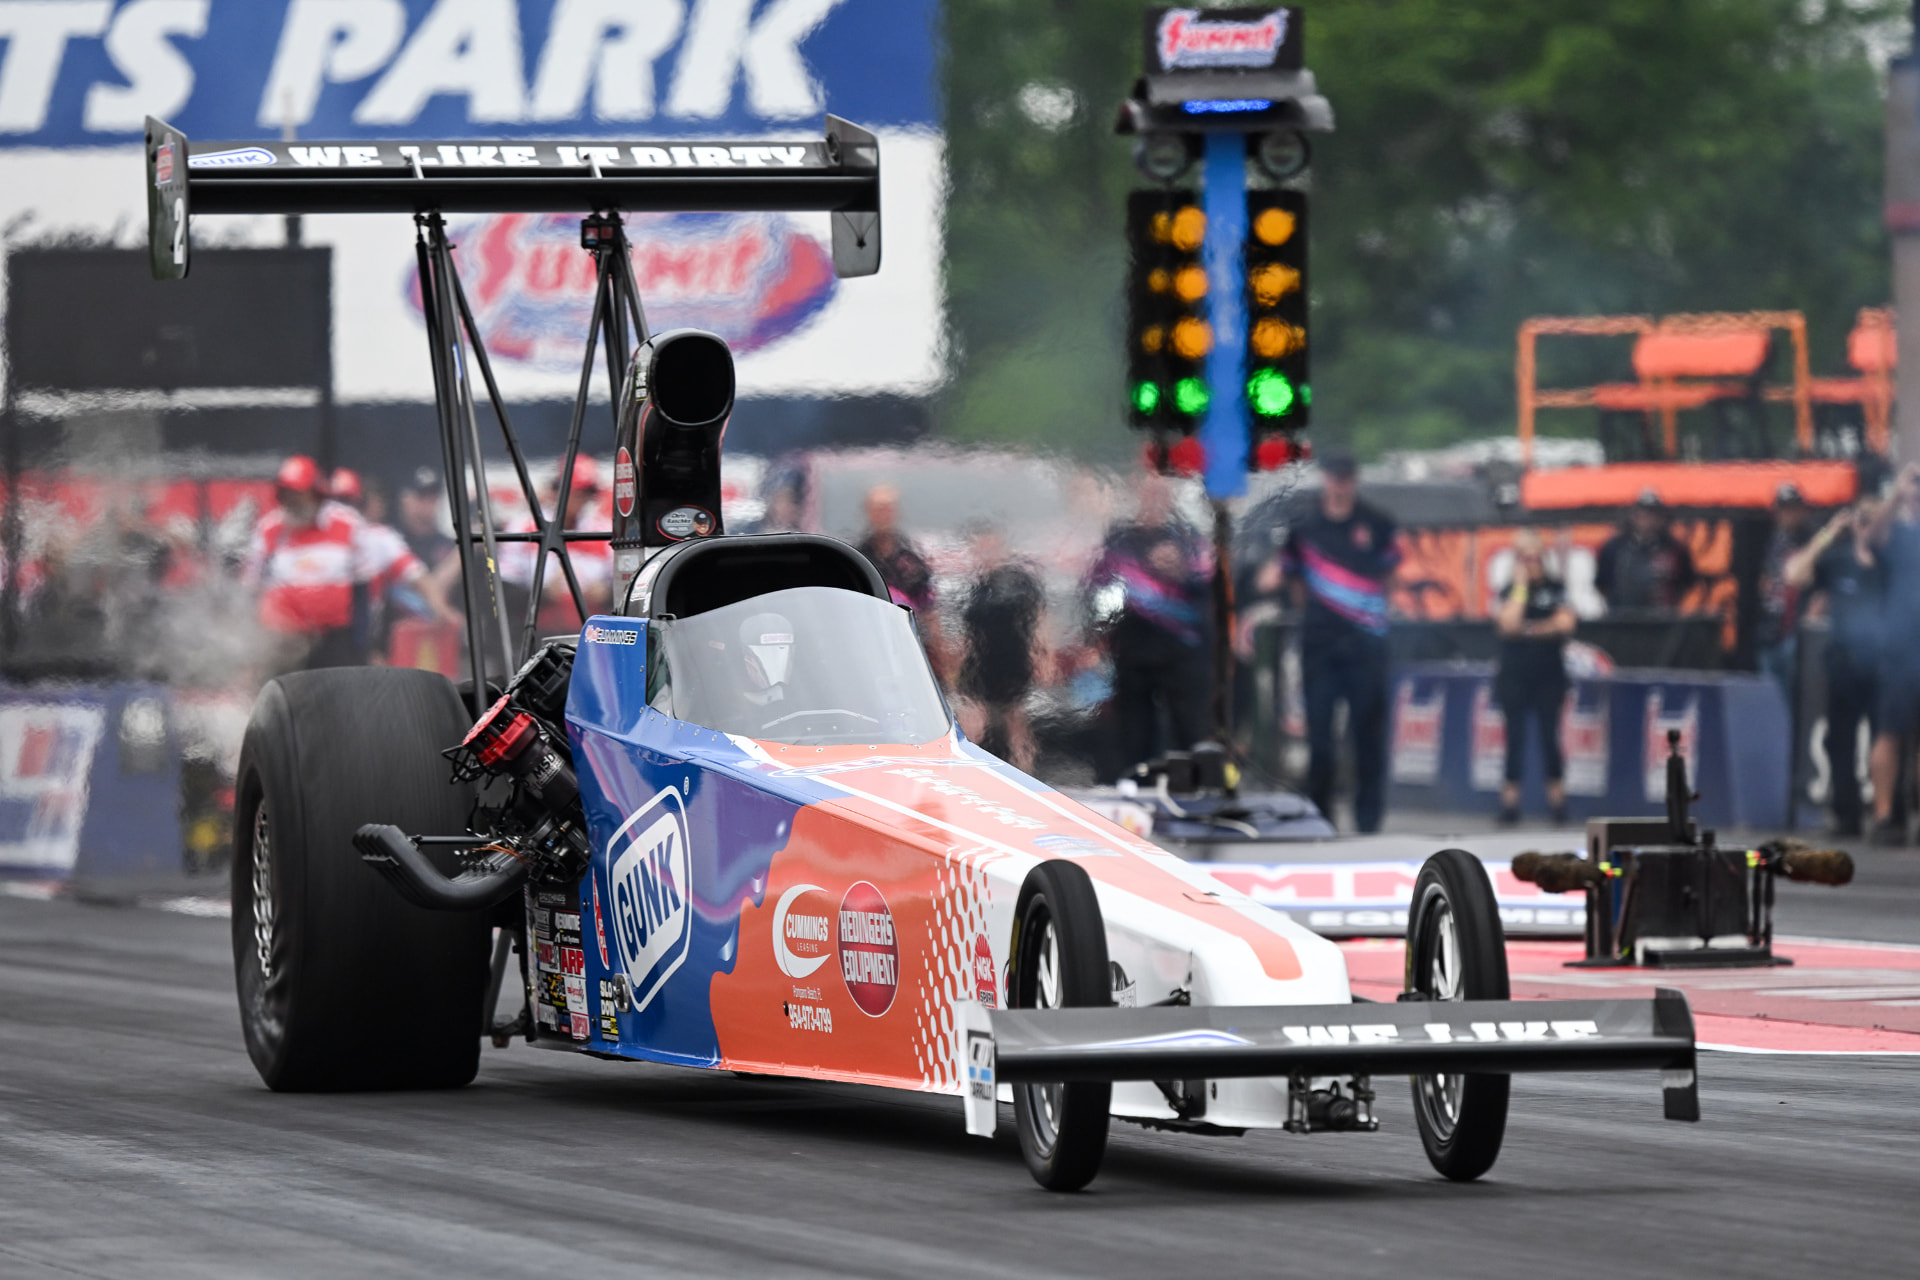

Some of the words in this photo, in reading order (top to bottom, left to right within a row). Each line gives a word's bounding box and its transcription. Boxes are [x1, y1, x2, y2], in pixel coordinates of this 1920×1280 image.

[256, 0, 845, 124] PARK
[192, 154, 262, 167] GUNK
[289, 146, 383, 167] WE
[400, 145, 540, 167] LIKE
[556, 146, 620, 167] IT
[630, 146, 806, 167] DIRTY
[173, 198, 184, 264] 2
[533, 752, 556, 779] MSD
[617, 832, 681, 962] GUNK
[786, 913, 829, 942] CUMMINGS
[839, 909, 894, 946] HEDINGER'S
[561, 948, 584, 975] ARP
[796, 943, 818, 953] LEASING
[842, 950, 896, 986] EQUIPMENT
[975, 956, 993, 981] NGK
[980, 990, 995, 1004] SPARK
[788, 1003, 832, 1034] 954-973-4799
[1283, 1024, 1398, 1044] WE
[1424, 1021, 1600, 1044] LIKE
